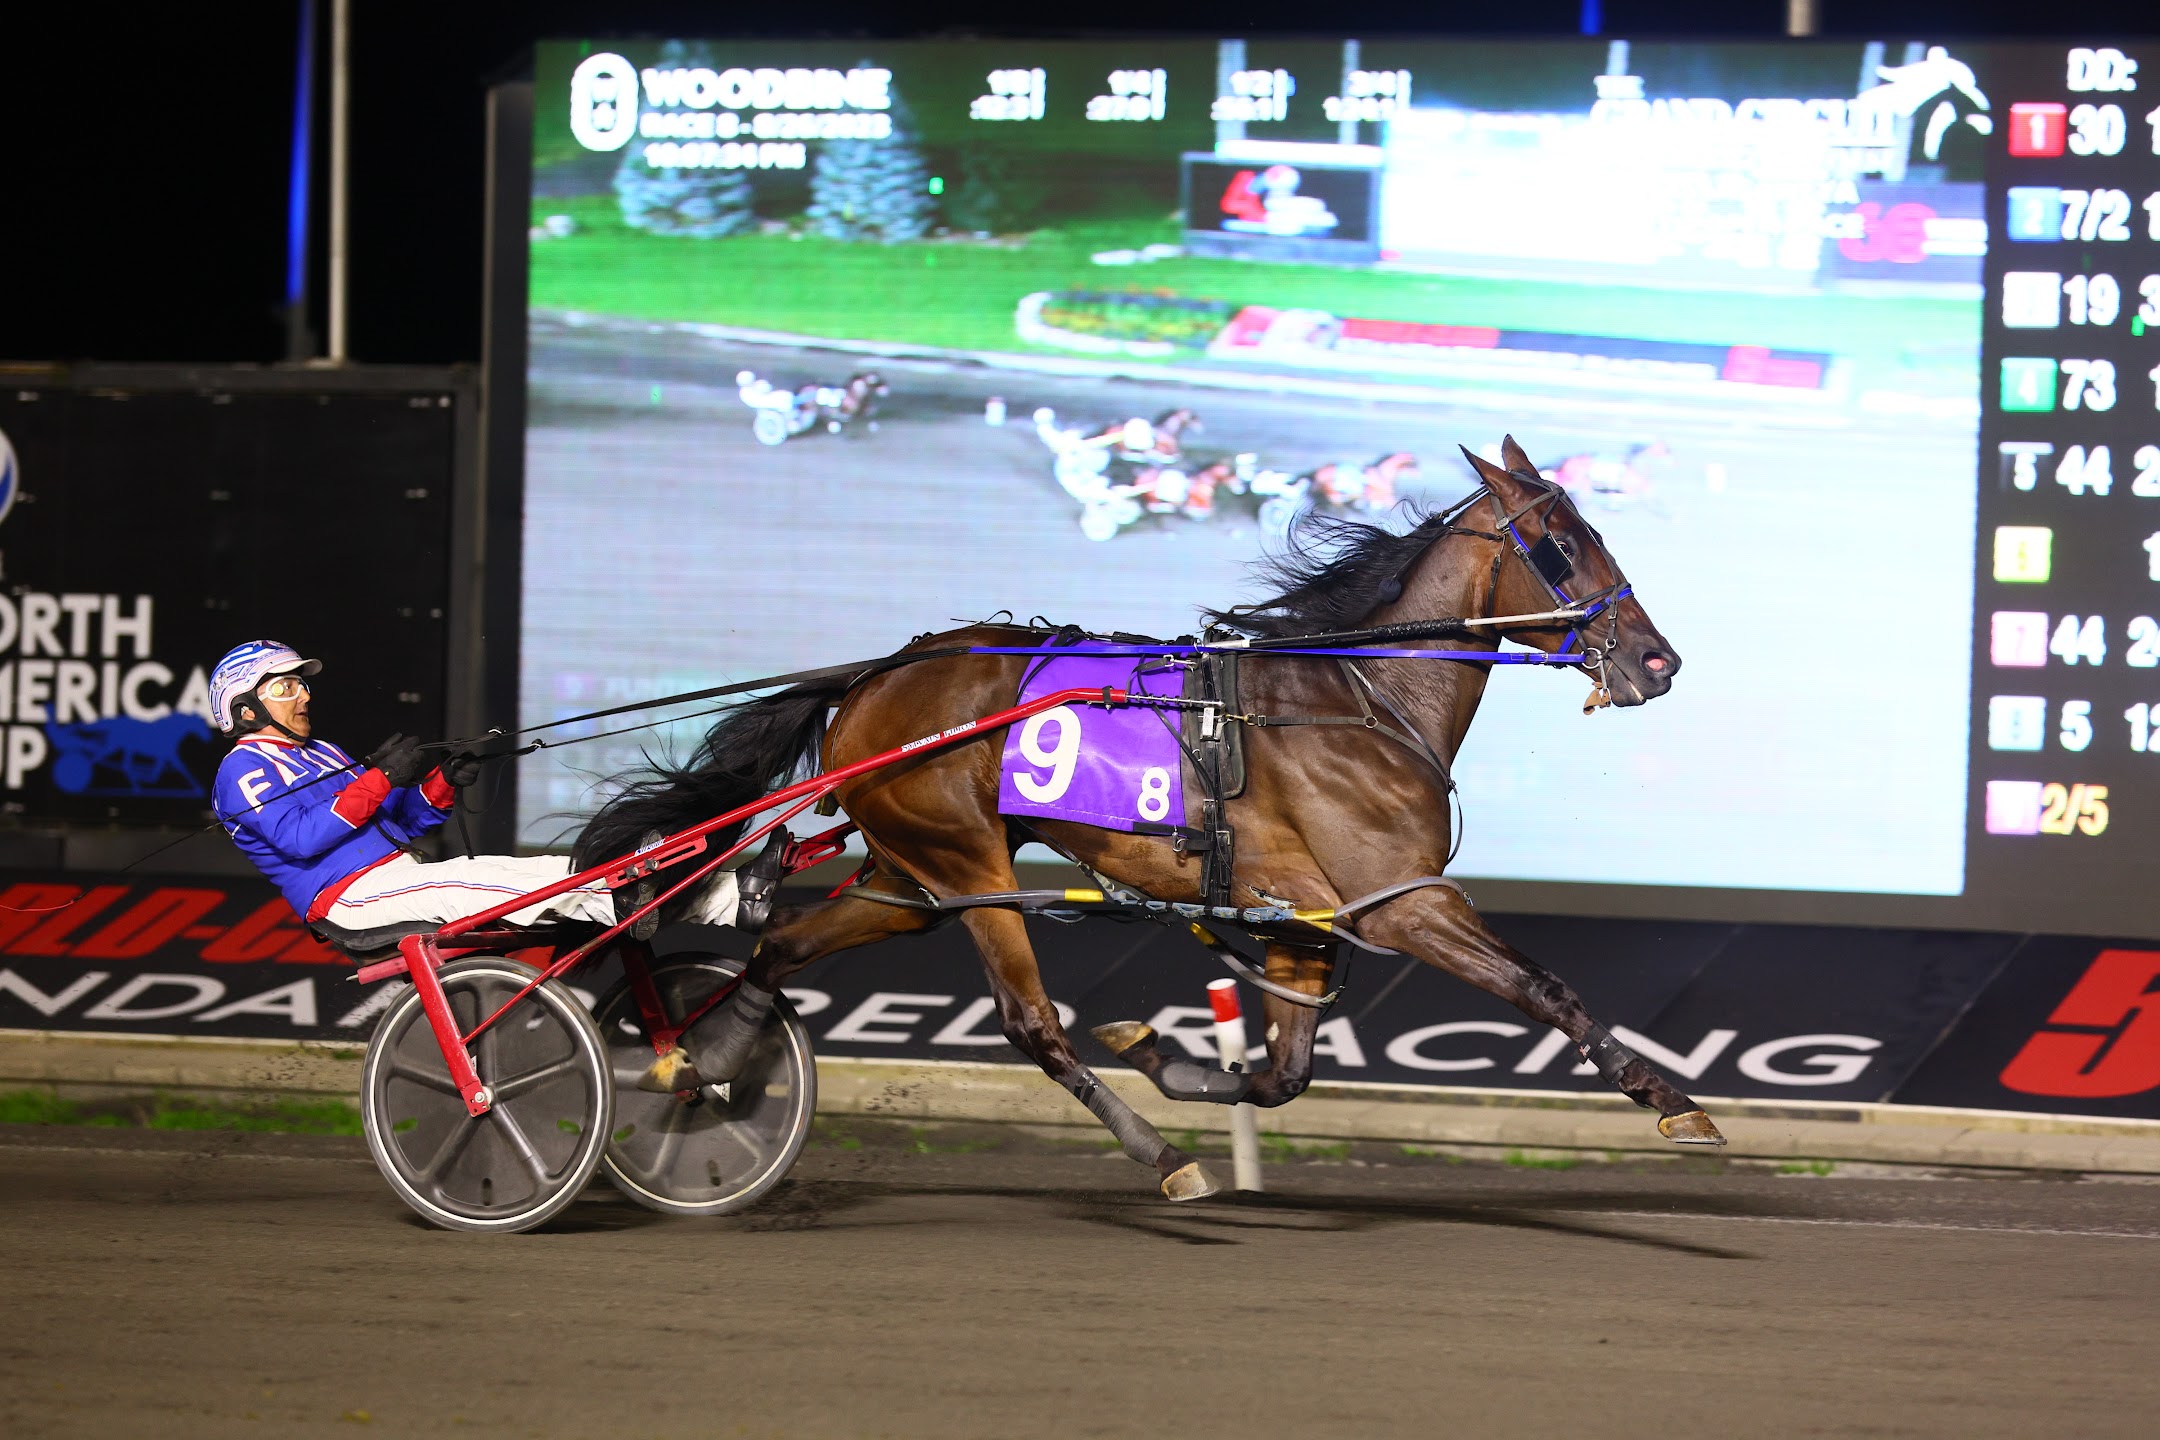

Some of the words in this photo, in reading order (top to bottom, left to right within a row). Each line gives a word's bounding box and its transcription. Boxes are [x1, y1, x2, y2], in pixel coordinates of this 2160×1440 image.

[2067, 104, 2126, 155] 30
[2060, 189, 2131, 241] 7/2
[2062, 273, 2120, 326] 19
[2060, 359, 2117, 411] 73
[2055, 444, 2113, 495] 44
[2050, 615, 2107, 666] 44
[2060, 700, 2093, 752] 5
[1012, 706, 1082, 803] 9
[237, 768, 272, 814] F
[1137, 766, 1171, 822] 8
[2040, 783, 2109, 835] 2/5
